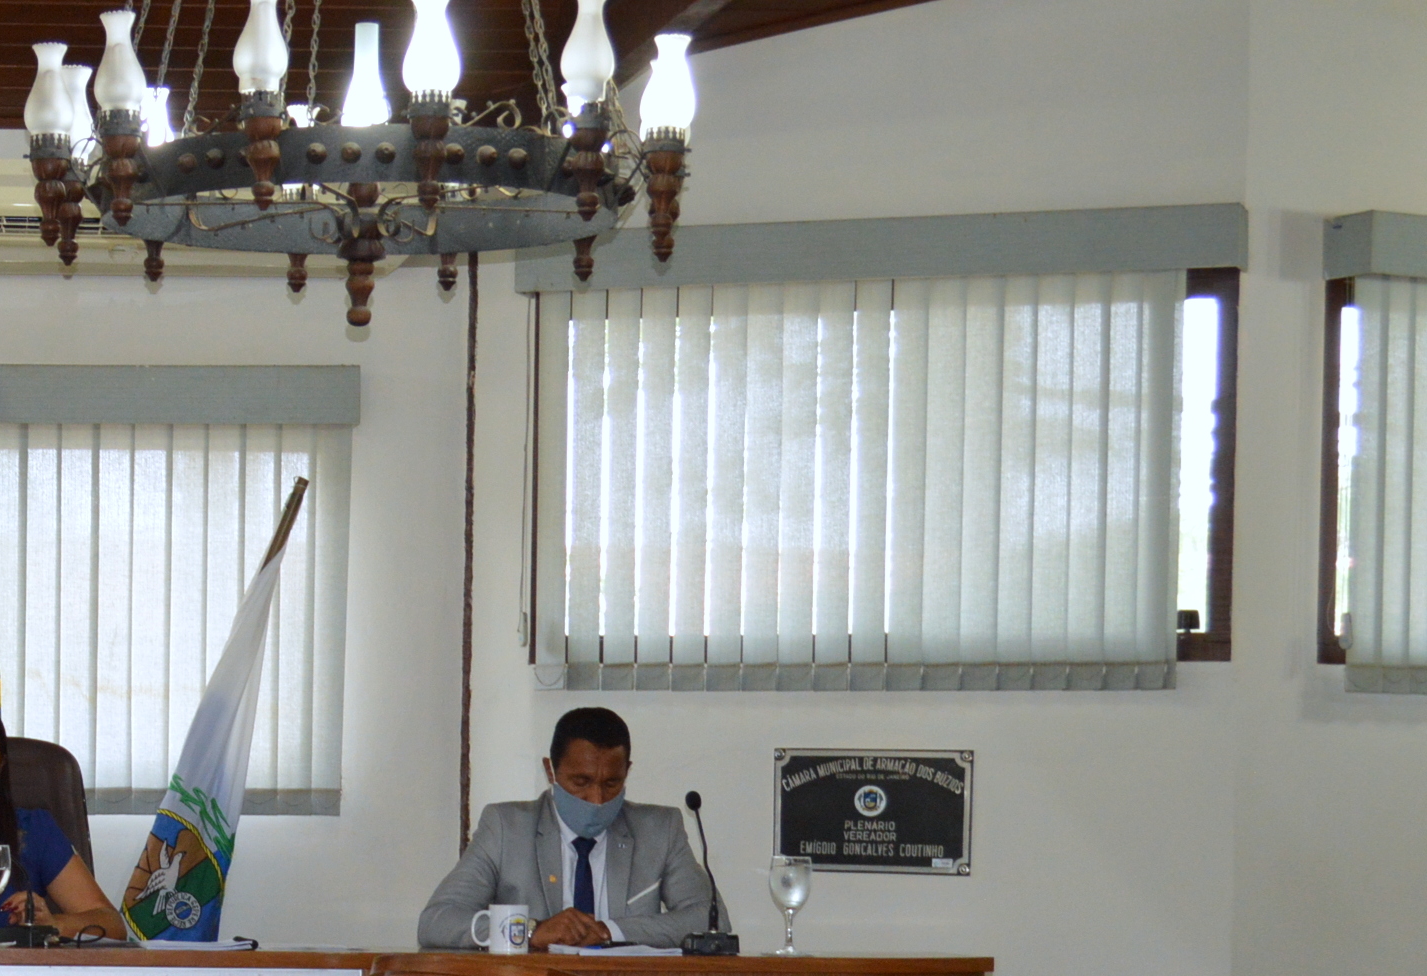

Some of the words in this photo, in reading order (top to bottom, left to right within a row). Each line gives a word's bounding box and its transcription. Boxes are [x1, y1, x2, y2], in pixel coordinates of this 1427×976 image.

[781, 767, 817, 792] CÂMARA
[816, 757, 862, 778] MUNICIPAL
[863, 756, 874, 770] DE
[875, 757, 917, 775] ARMAÇÃO
[916, 764, 935, 781] DOS
[933, 770, 964, 795] BÚZIOS
[844, 819, 896, 831] PLENÁRIO
[843, 830, 897, 842] VEREADOR
[899, 843, 945, 858] COUTINHO
